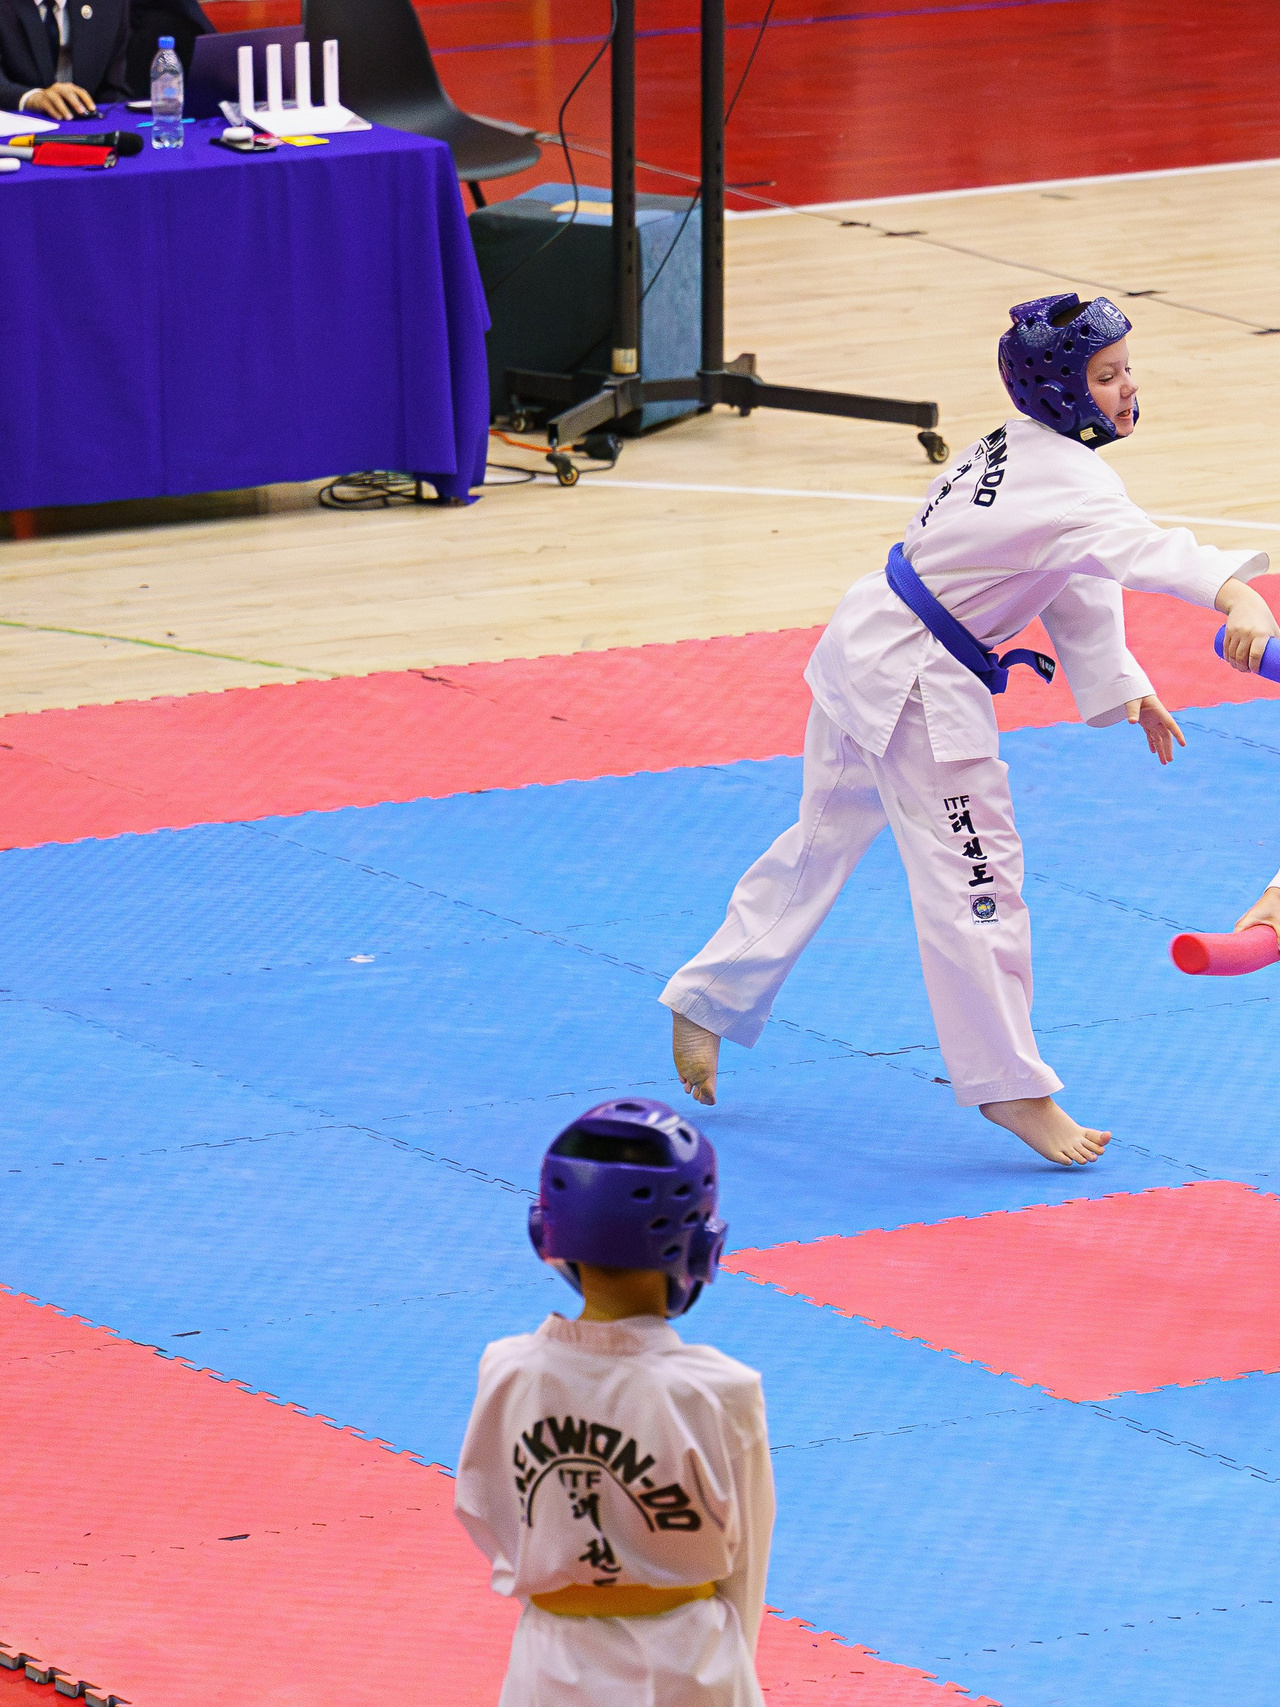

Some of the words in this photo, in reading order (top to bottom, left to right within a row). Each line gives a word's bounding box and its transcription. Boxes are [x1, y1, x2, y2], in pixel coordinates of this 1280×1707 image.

[943, 795, 970, 811] ITF
[948, 810, 994, 887] 태권도
[558, 1467, 601, 1489] ITF
